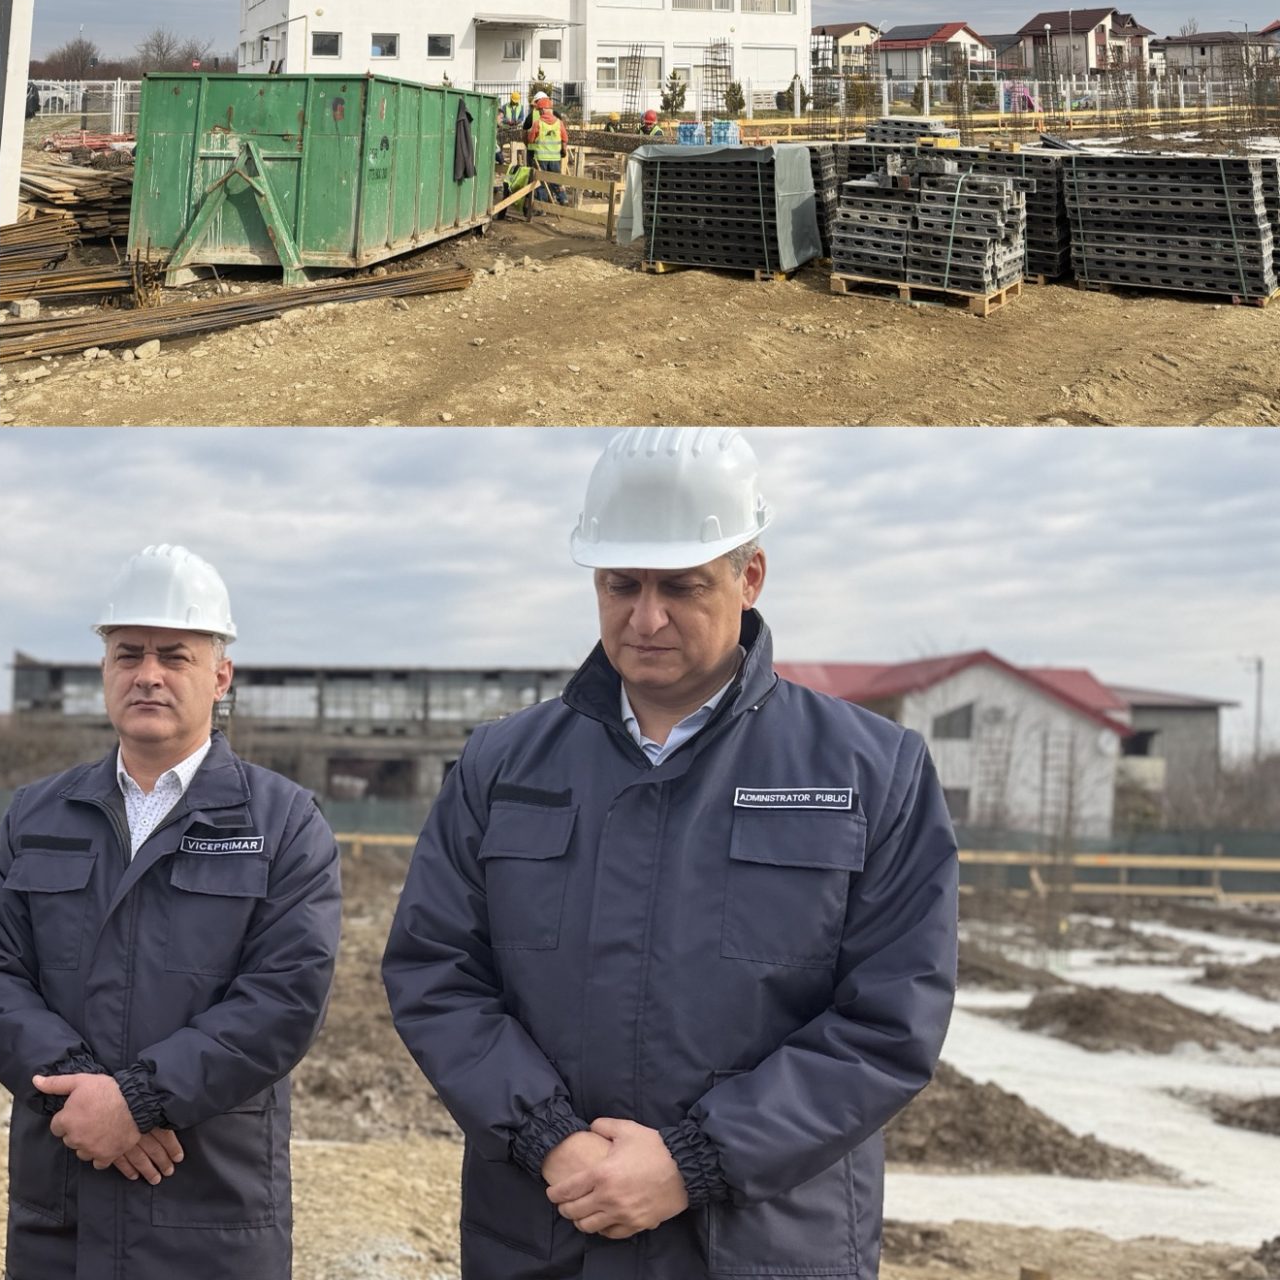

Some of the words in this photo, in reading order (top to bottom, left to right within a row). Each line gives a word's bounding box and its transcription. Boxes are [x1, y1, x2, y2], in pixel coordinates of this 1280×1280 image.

[739, 794, 811, 802] ADMINISTRATOR
[815, 794, 848, 803] PUBLIC
[187, 840, 258, 851] VICEPRIMAR
